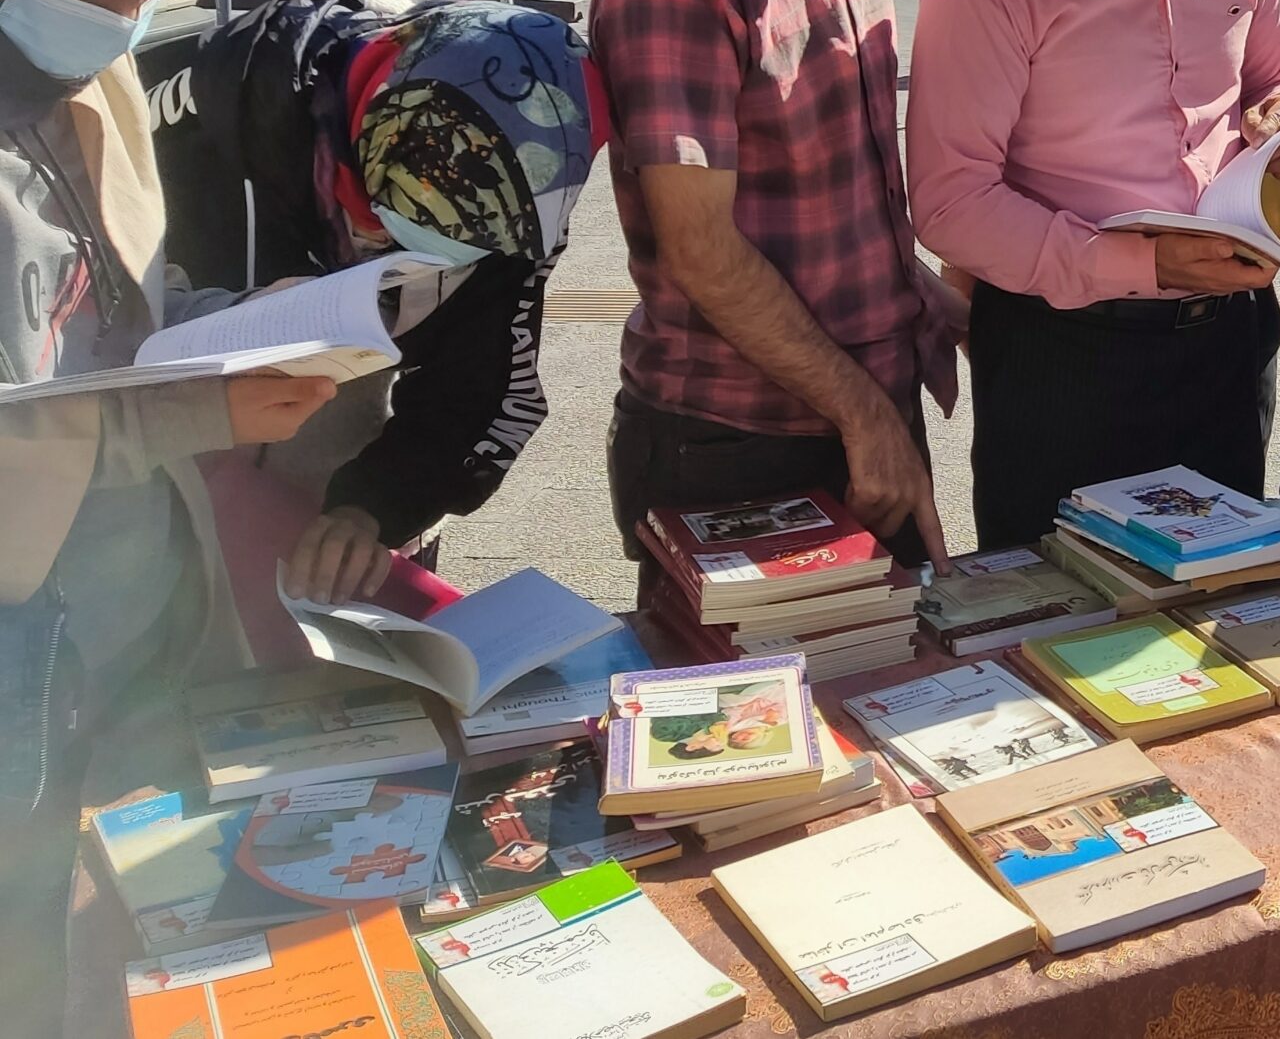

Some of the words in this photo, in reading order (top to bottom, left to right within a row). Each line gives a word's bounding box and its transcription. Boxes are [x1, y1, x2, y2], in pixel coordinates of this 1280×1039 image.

[498, 689, 570, 716] Thought
[722, 763, 746, 773] خوب
[747, 758, 787, 770] بیاموزیم
[452, 775, 579, 815] شریعتی
[480, 810, 523, 826] آنچه
[886, 912, 926, 934] صادق
